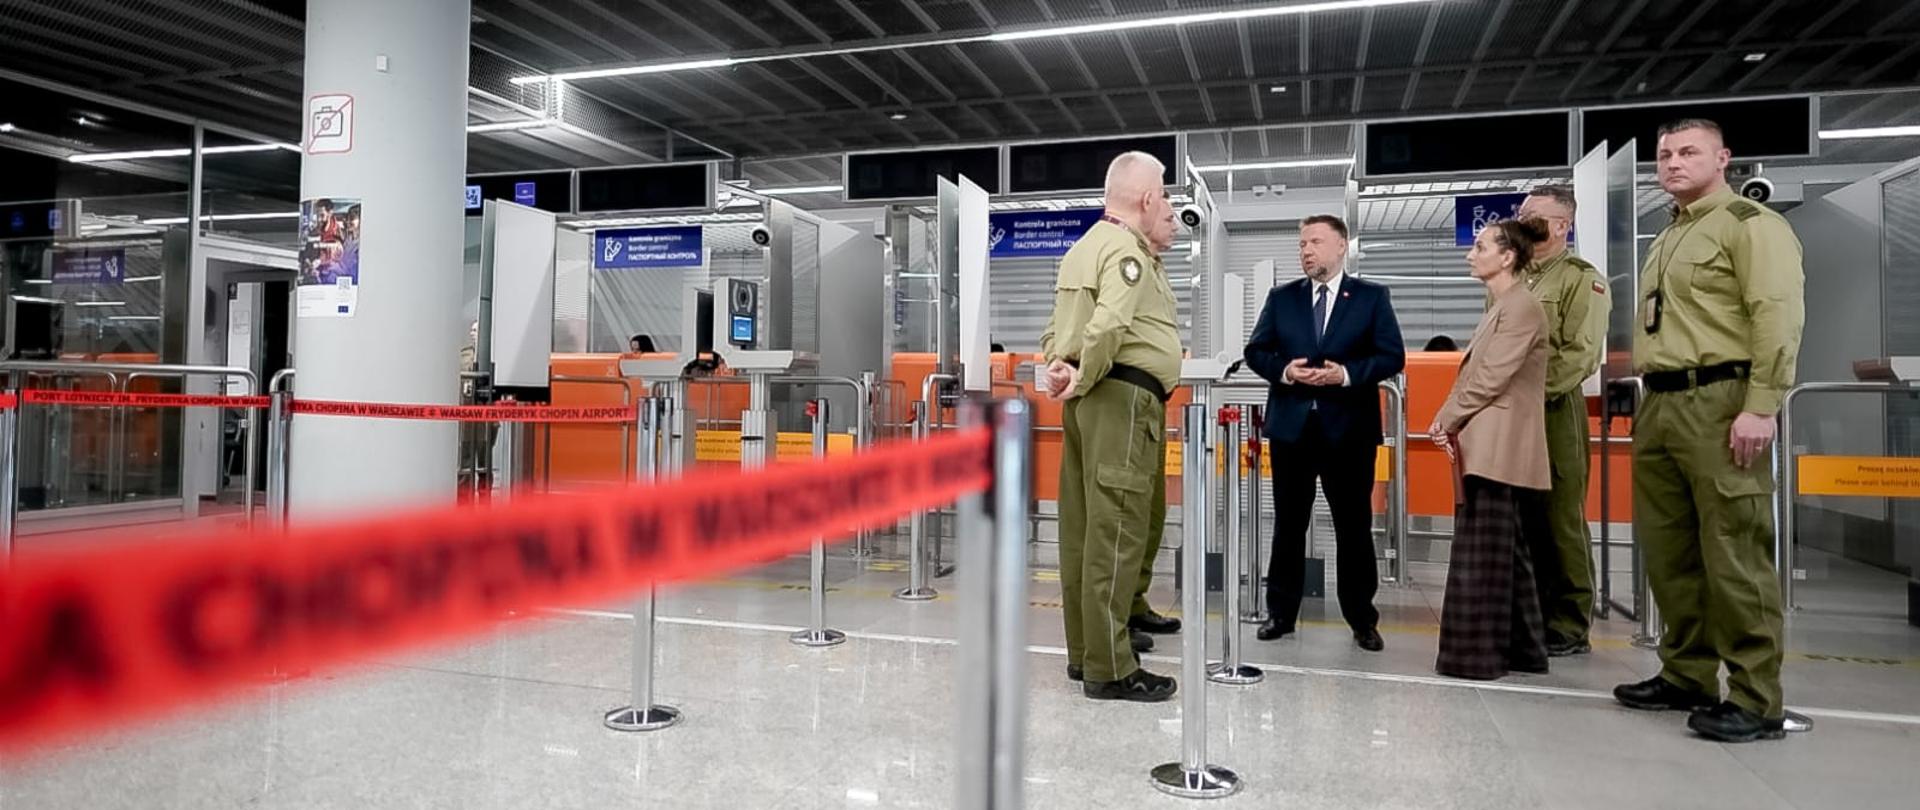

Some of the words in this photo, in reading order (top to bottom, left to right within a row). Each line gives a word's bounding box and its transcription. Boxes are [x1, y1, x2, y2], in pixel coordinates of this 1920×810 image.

[1013, 219, 1045, 228] Kontrola
[1046, 217, 1081, 229] graniczna
[1013, 231, 1038, 239] Border
[1039, 229, 1064, 238] control
[33, 390, 61, 401] PORT
[315, 402, 356, 414] CHOPINA
[358, 404, 367, 414] W
[368, 404, 425, 417] WARSZAWIE
[440, 407, 483, 419] WARSAW
[485, 408, 537, 419] FRYDERYK
[540, 408, 579, 419] CHOPIN
[582, 408, 629, 419] AIRPORT
